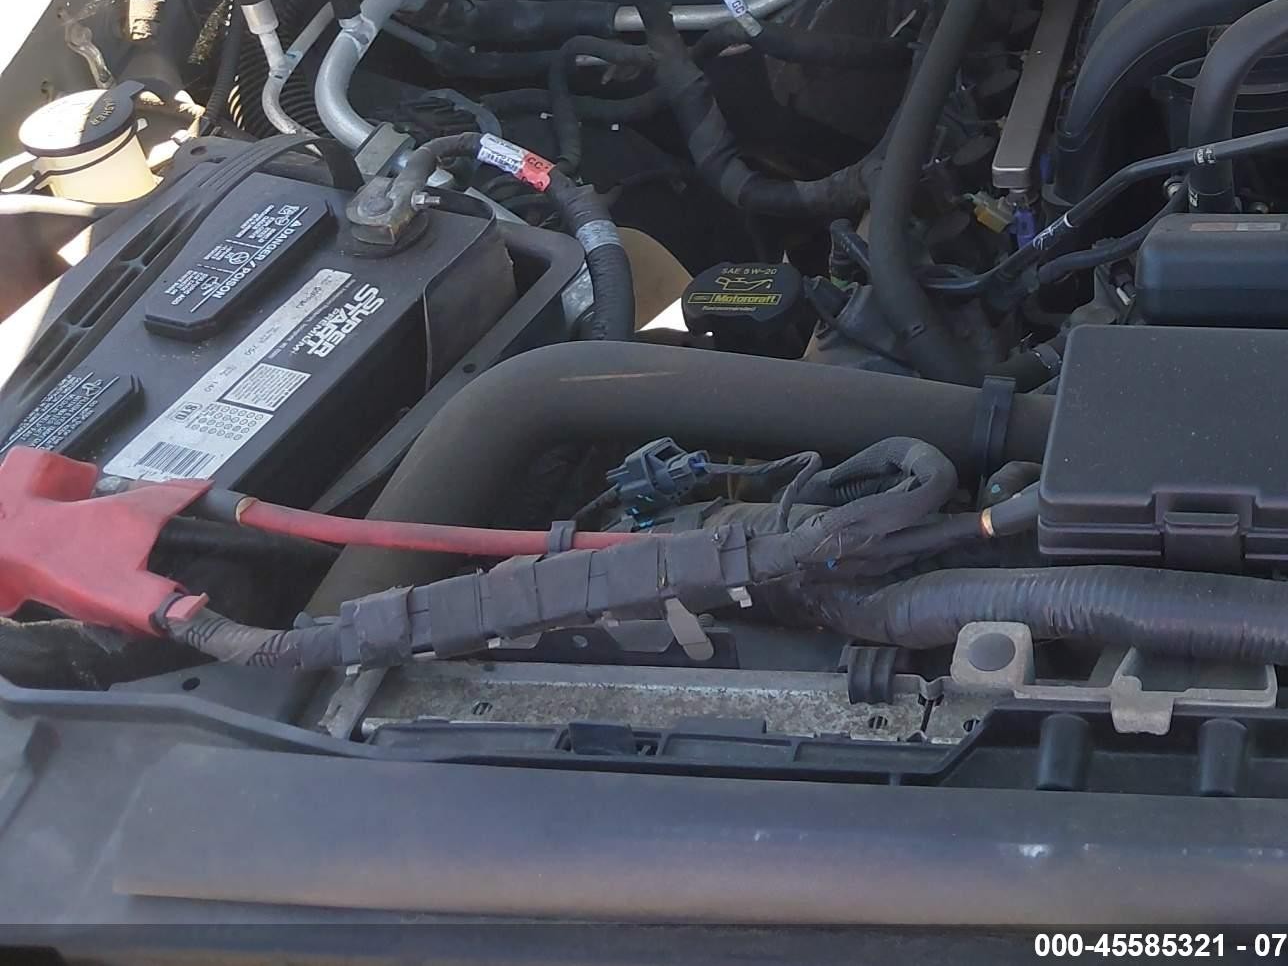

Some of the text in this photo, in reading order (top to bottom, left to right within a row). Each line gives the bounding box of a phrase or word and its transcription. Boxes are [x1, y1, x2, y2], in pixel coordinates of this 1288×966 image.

[255, 228, 296, 261] DANGER
[212, 267, 251, 299] POISON
[721, 267, 741, 275] SAE
[714, 295, 776, 304] Motorcraft
[307, 284, 379, 355] START
[314, 296, 385, 358] SUPER
